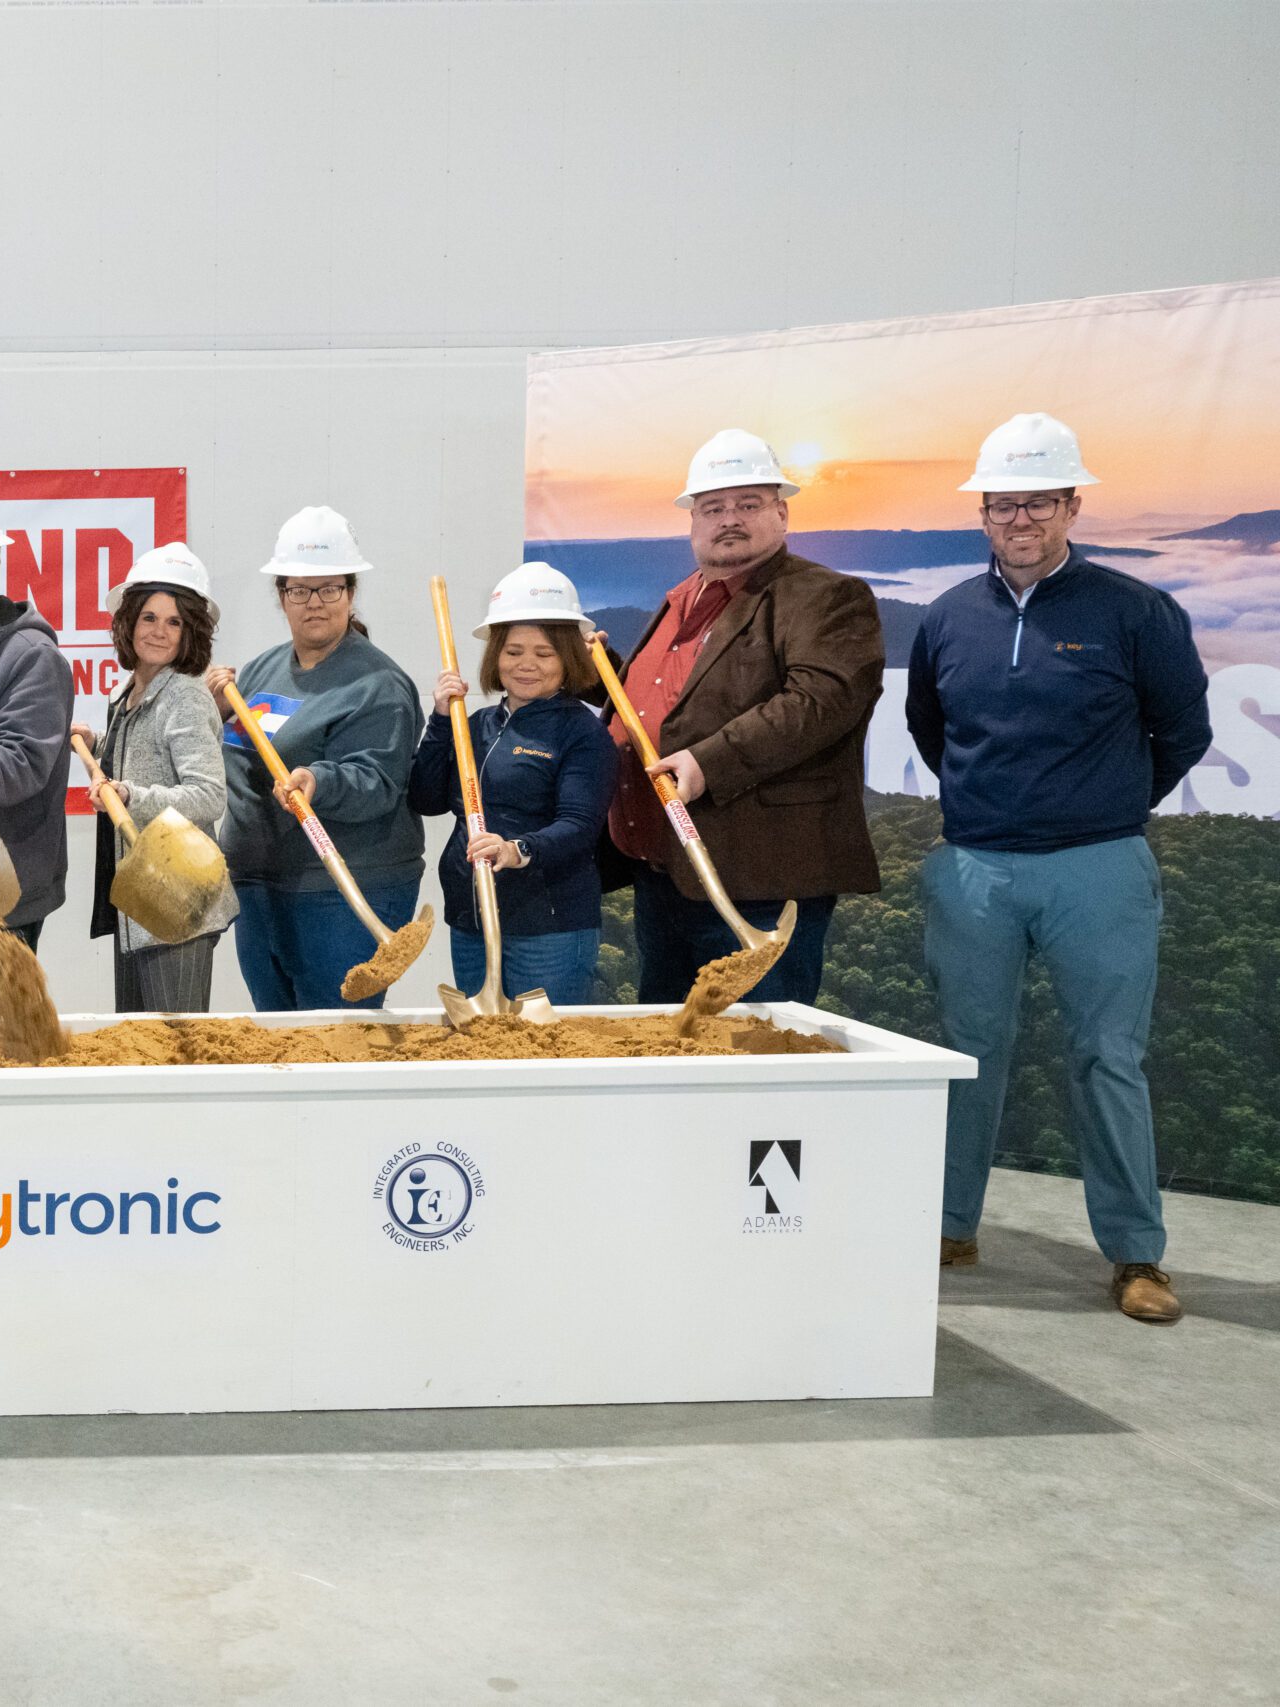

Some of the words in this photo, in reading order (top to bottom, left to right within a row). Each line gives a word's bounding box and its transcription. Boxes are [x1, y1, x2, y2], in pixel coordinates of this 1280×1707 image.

[521, 748, 553, 759] keytronic
[372, 1142, 421, 1200] INTEGRATED
[436, 1141, 486, 1198] CONSULTING
[742, 1215, 803, 1228] ADAMS
[382, 1221, 449, 1252] ENGINEERS,
[452, 1222, 476, 1244] INC.
